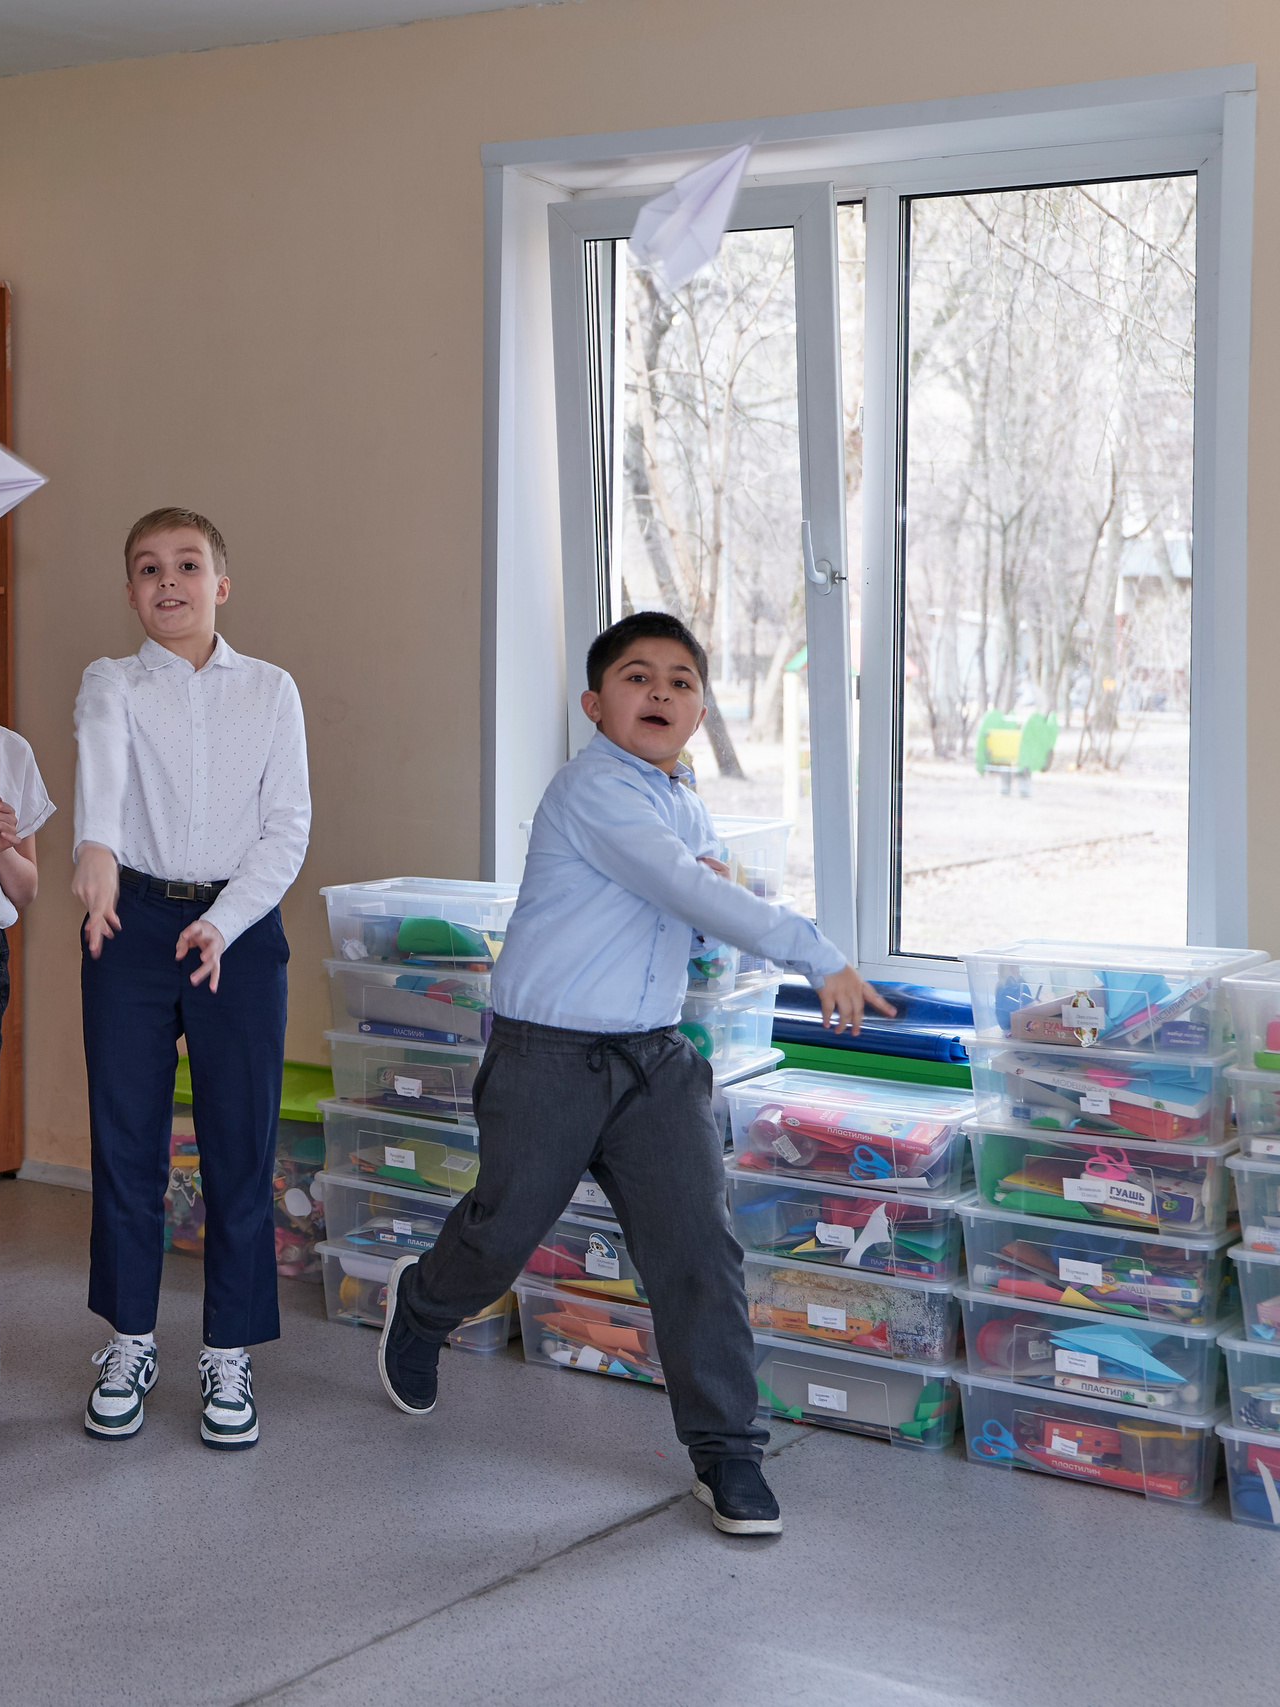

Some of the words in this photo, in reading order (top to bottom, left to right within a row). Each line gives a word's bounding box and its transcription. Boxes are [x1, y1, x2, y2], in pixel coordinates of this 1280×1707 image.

[1189, 988, 1205, 1001] 12
[1145, 997, 1189, 1030] ПЛАСТИЛИН
[393, 1028, 425, 1038] ПЛАСТИЛИН
[1057, 1031, 1067, 1039] 12
[586, 1189, 595, 1197] 12
[1109, 1186, 1145, 1202] ГУАШЬ
[805, 1207, 813, 1216] 12
[1081, 1382, 1136, 1400] ПЛАСТИЛИН
